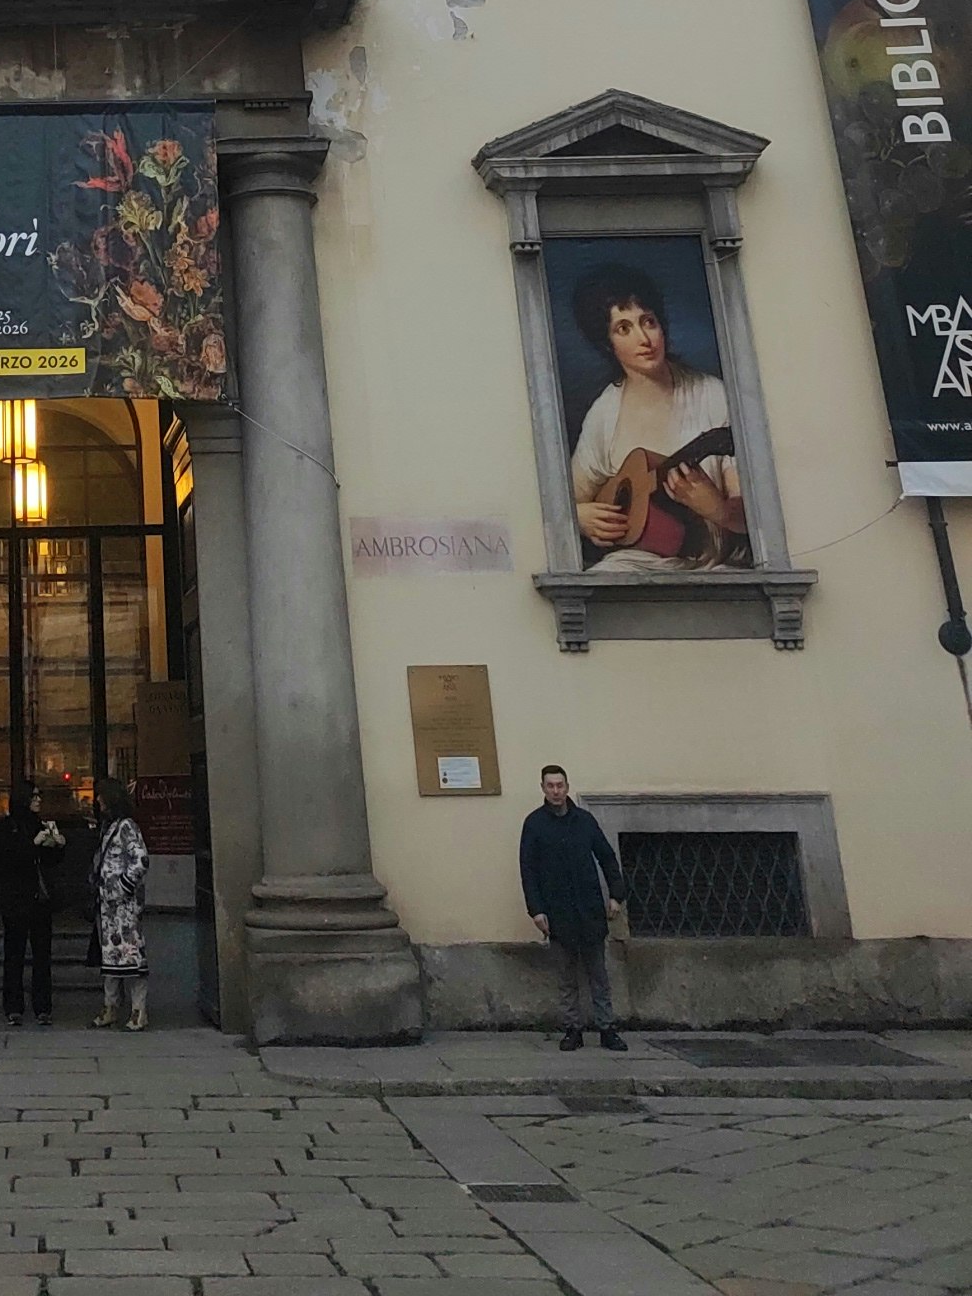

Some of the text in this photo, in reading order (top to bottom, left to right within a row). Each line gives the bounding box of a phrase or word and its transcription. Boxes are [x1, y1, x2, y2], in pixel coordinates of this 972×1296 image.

[38, 355, 79, 368] 2026
[927, 421, 972, 432] www.a
[355, 535, 510, 558] AMBROSIANA
